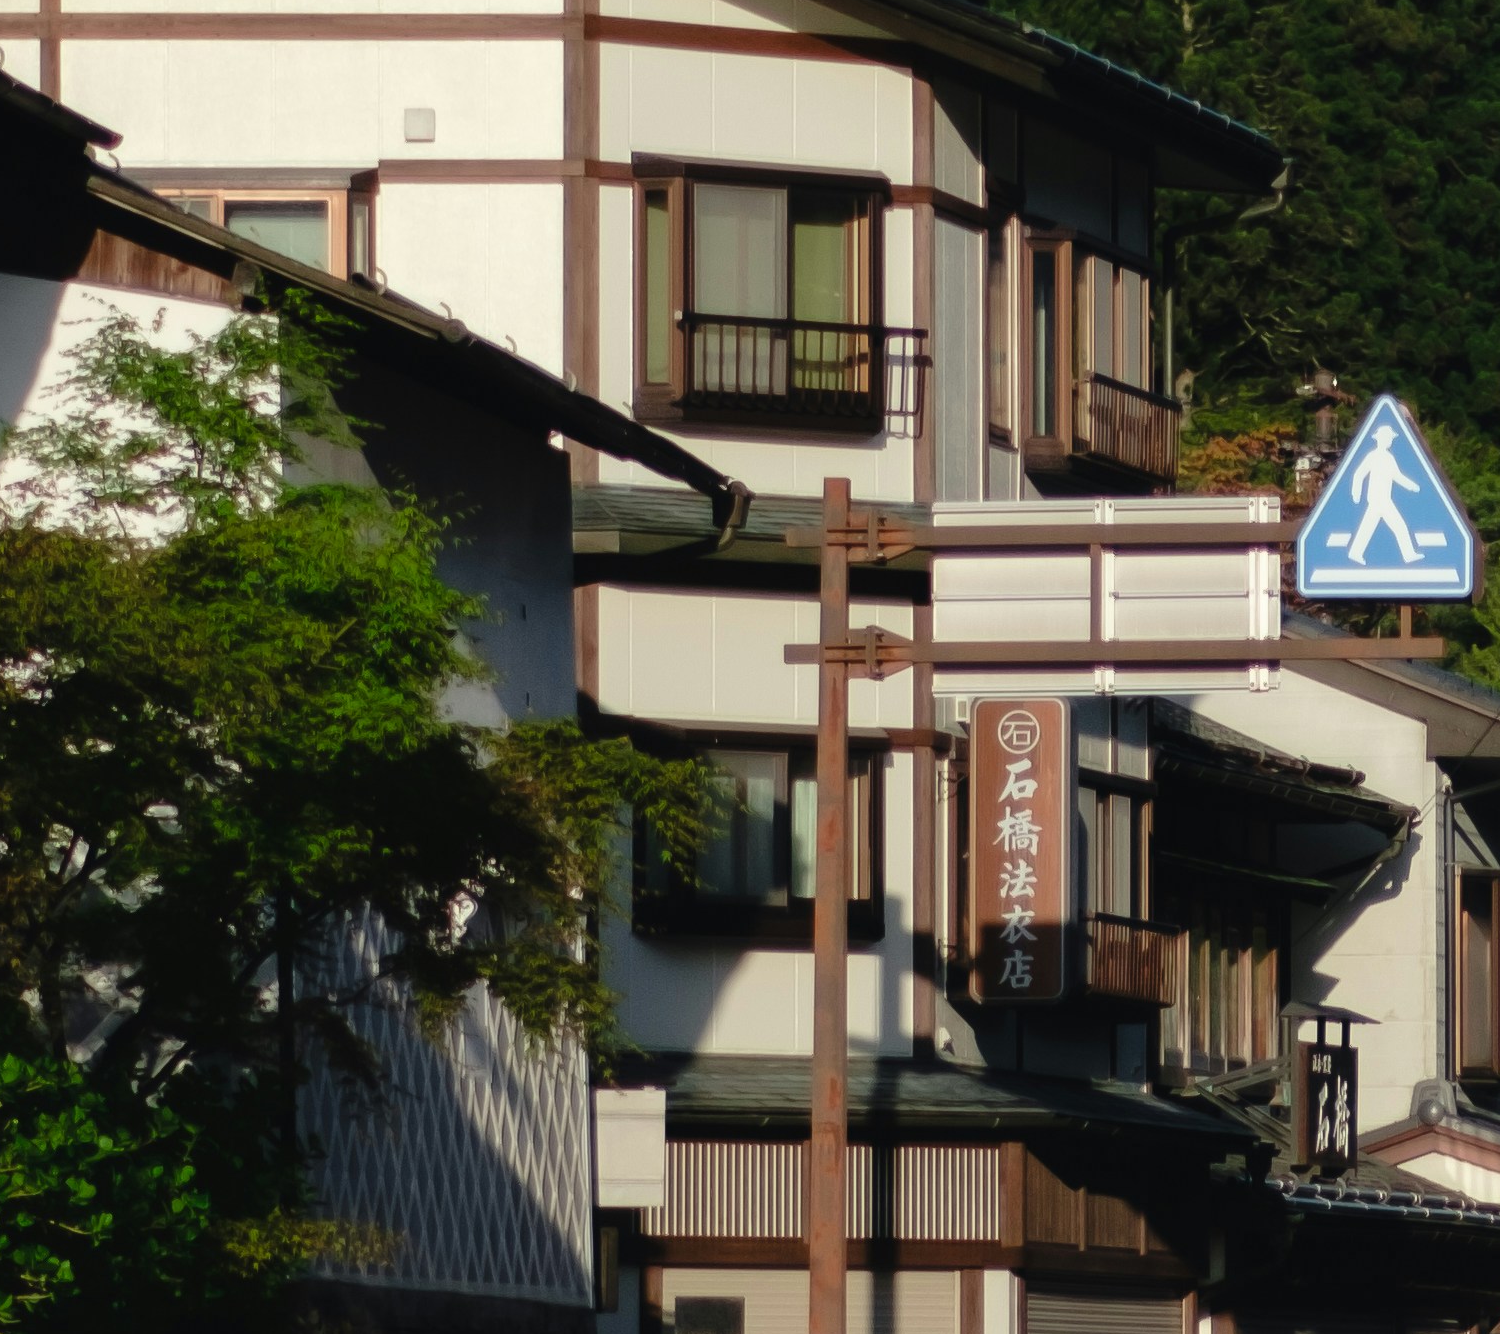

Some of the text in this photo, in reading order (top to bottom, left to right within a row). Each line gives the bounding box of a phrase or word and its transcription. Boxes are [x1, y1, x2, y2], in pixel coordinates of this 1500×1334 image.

[993, 714, 1043, 990] 石 石橋法衣店
